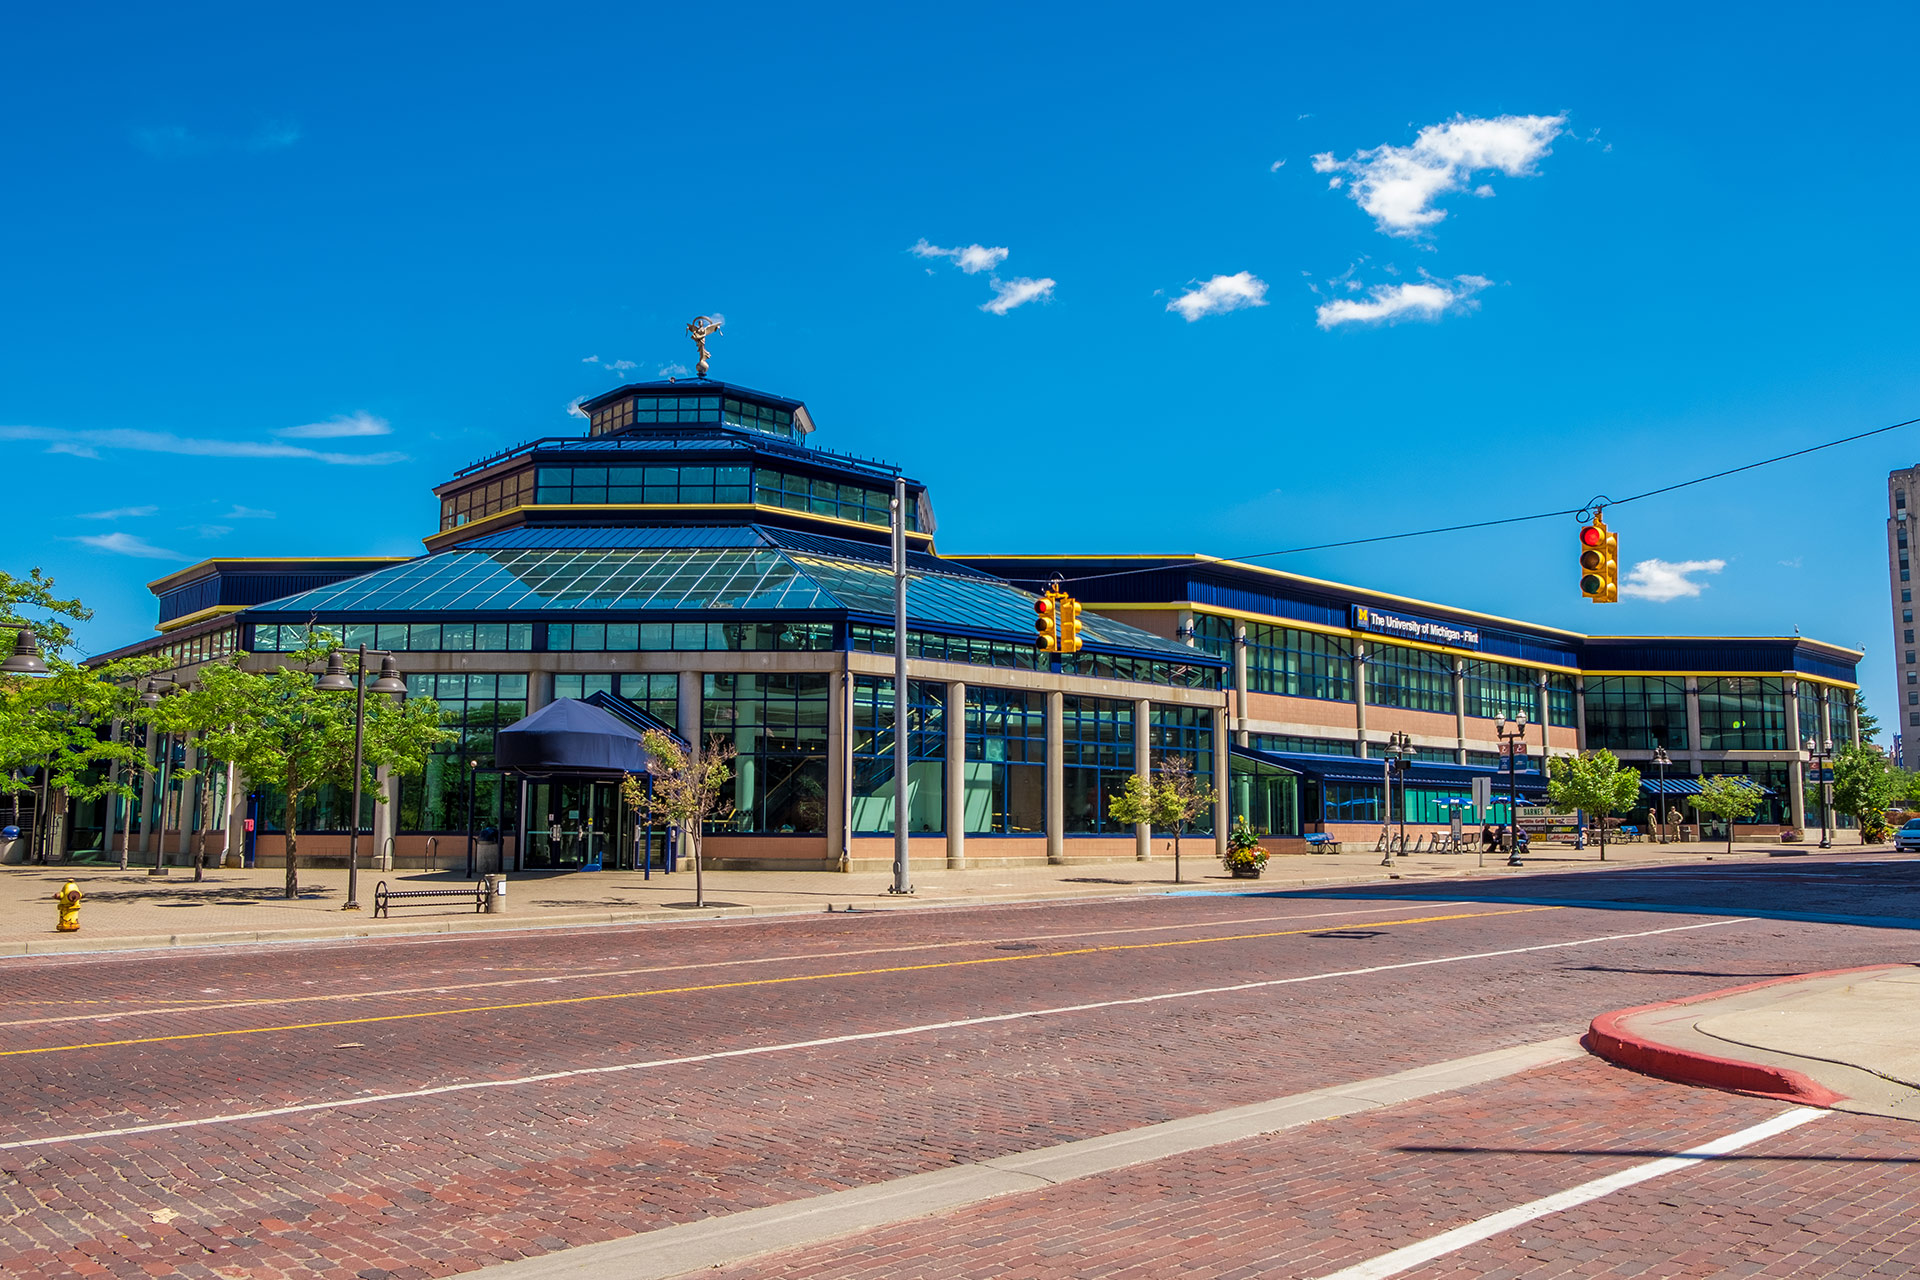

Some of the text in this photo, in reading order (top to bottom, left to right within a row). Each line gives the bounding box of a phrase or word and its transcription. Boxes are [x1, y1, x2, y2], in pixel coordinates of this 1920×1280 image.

[1370, 613, 1385, 627] The
[1385, 616, 1420, 636] University
[1421, 623, 1430, 635] of
[1430, 624, 1460, 642] Michigan
[1464, 630, 1479, 644] Flint
